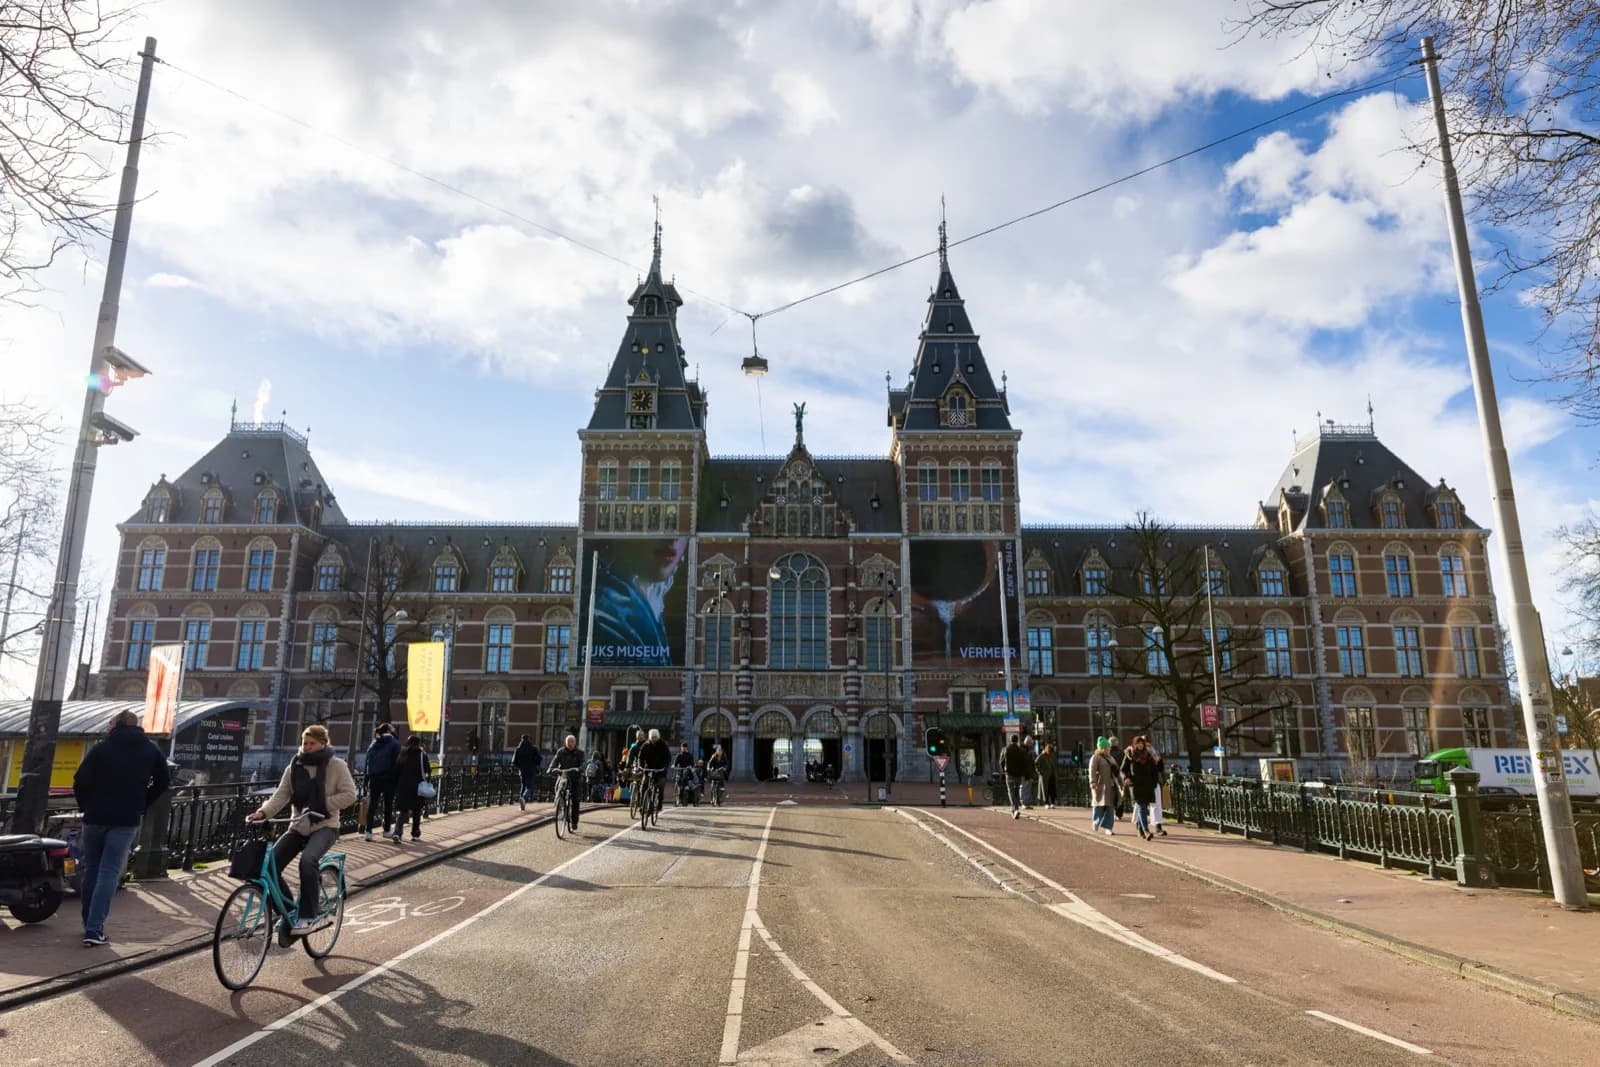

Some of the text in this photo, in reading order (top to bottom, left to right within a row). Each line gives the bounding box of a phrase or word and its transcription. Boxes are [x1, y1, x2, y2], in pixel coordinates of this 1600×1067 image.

[616, 645, 670, 657] MUSEUM
[960, 647, 1017, 659] VERMER
[1494, 754, 1592, 775] REEX
